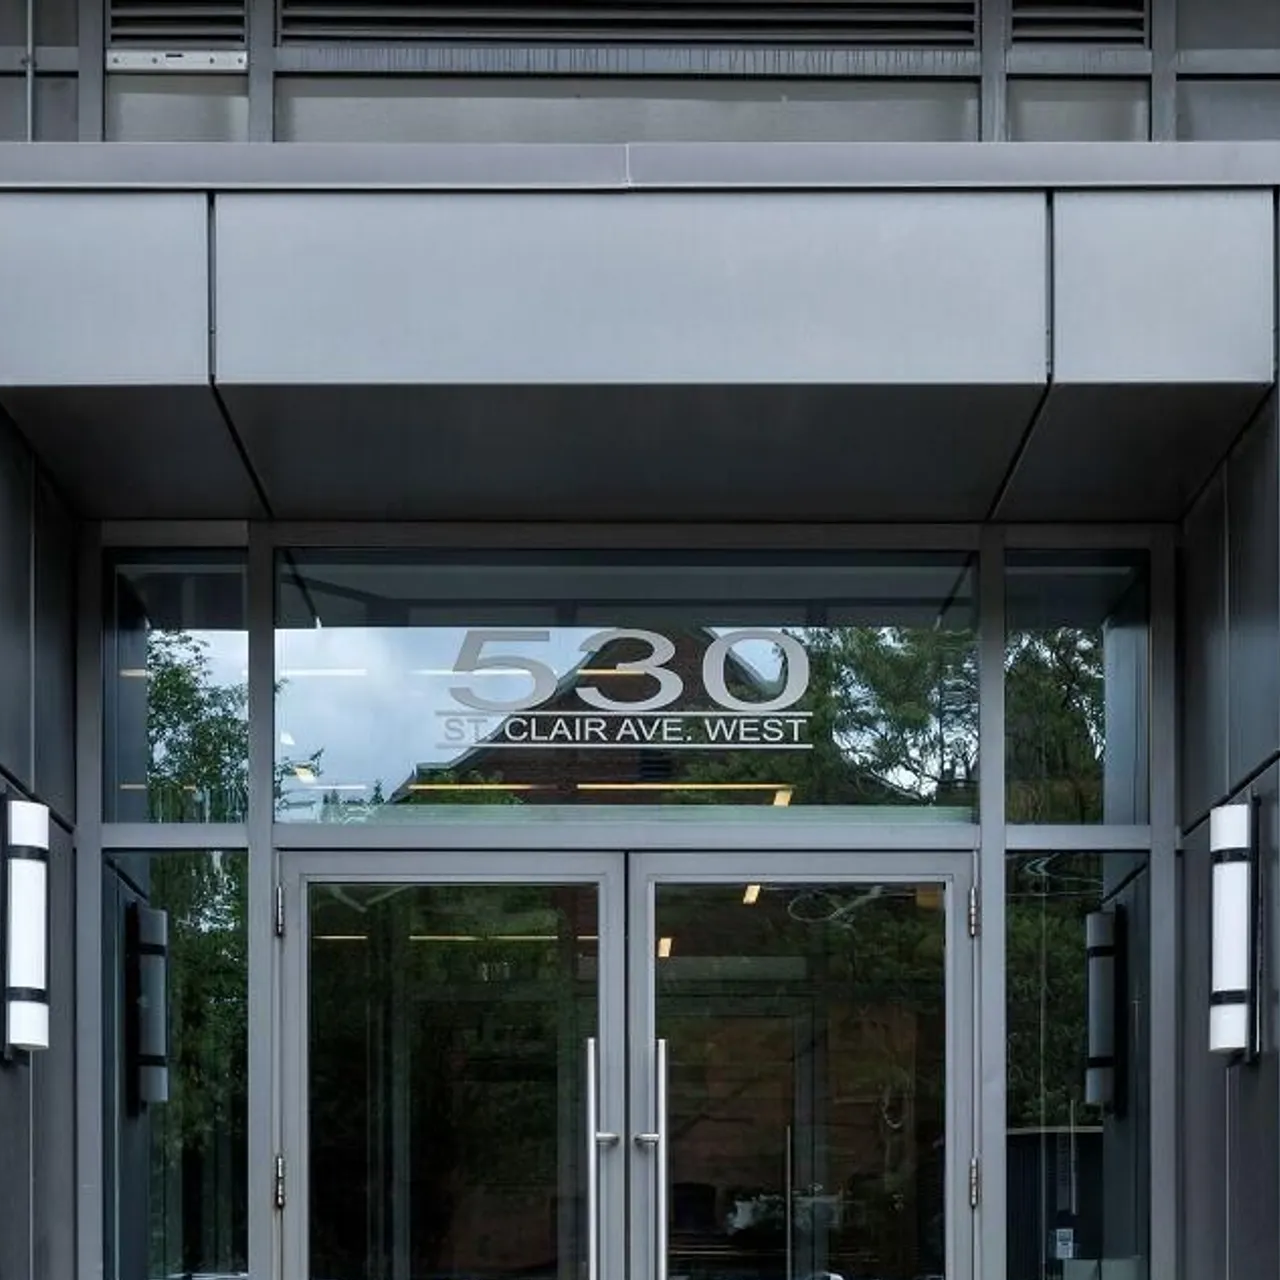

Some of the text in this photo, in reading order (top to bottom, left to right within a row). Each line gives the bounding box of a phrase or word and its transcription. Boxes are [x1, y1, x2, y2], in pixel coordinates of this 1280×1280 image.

[449, 627, 810, 712] 530
[504, 717, 608, 741] CLAIR
[615, 718, 692, 741] AVE.
[704, 718, 807, 741] WEST
